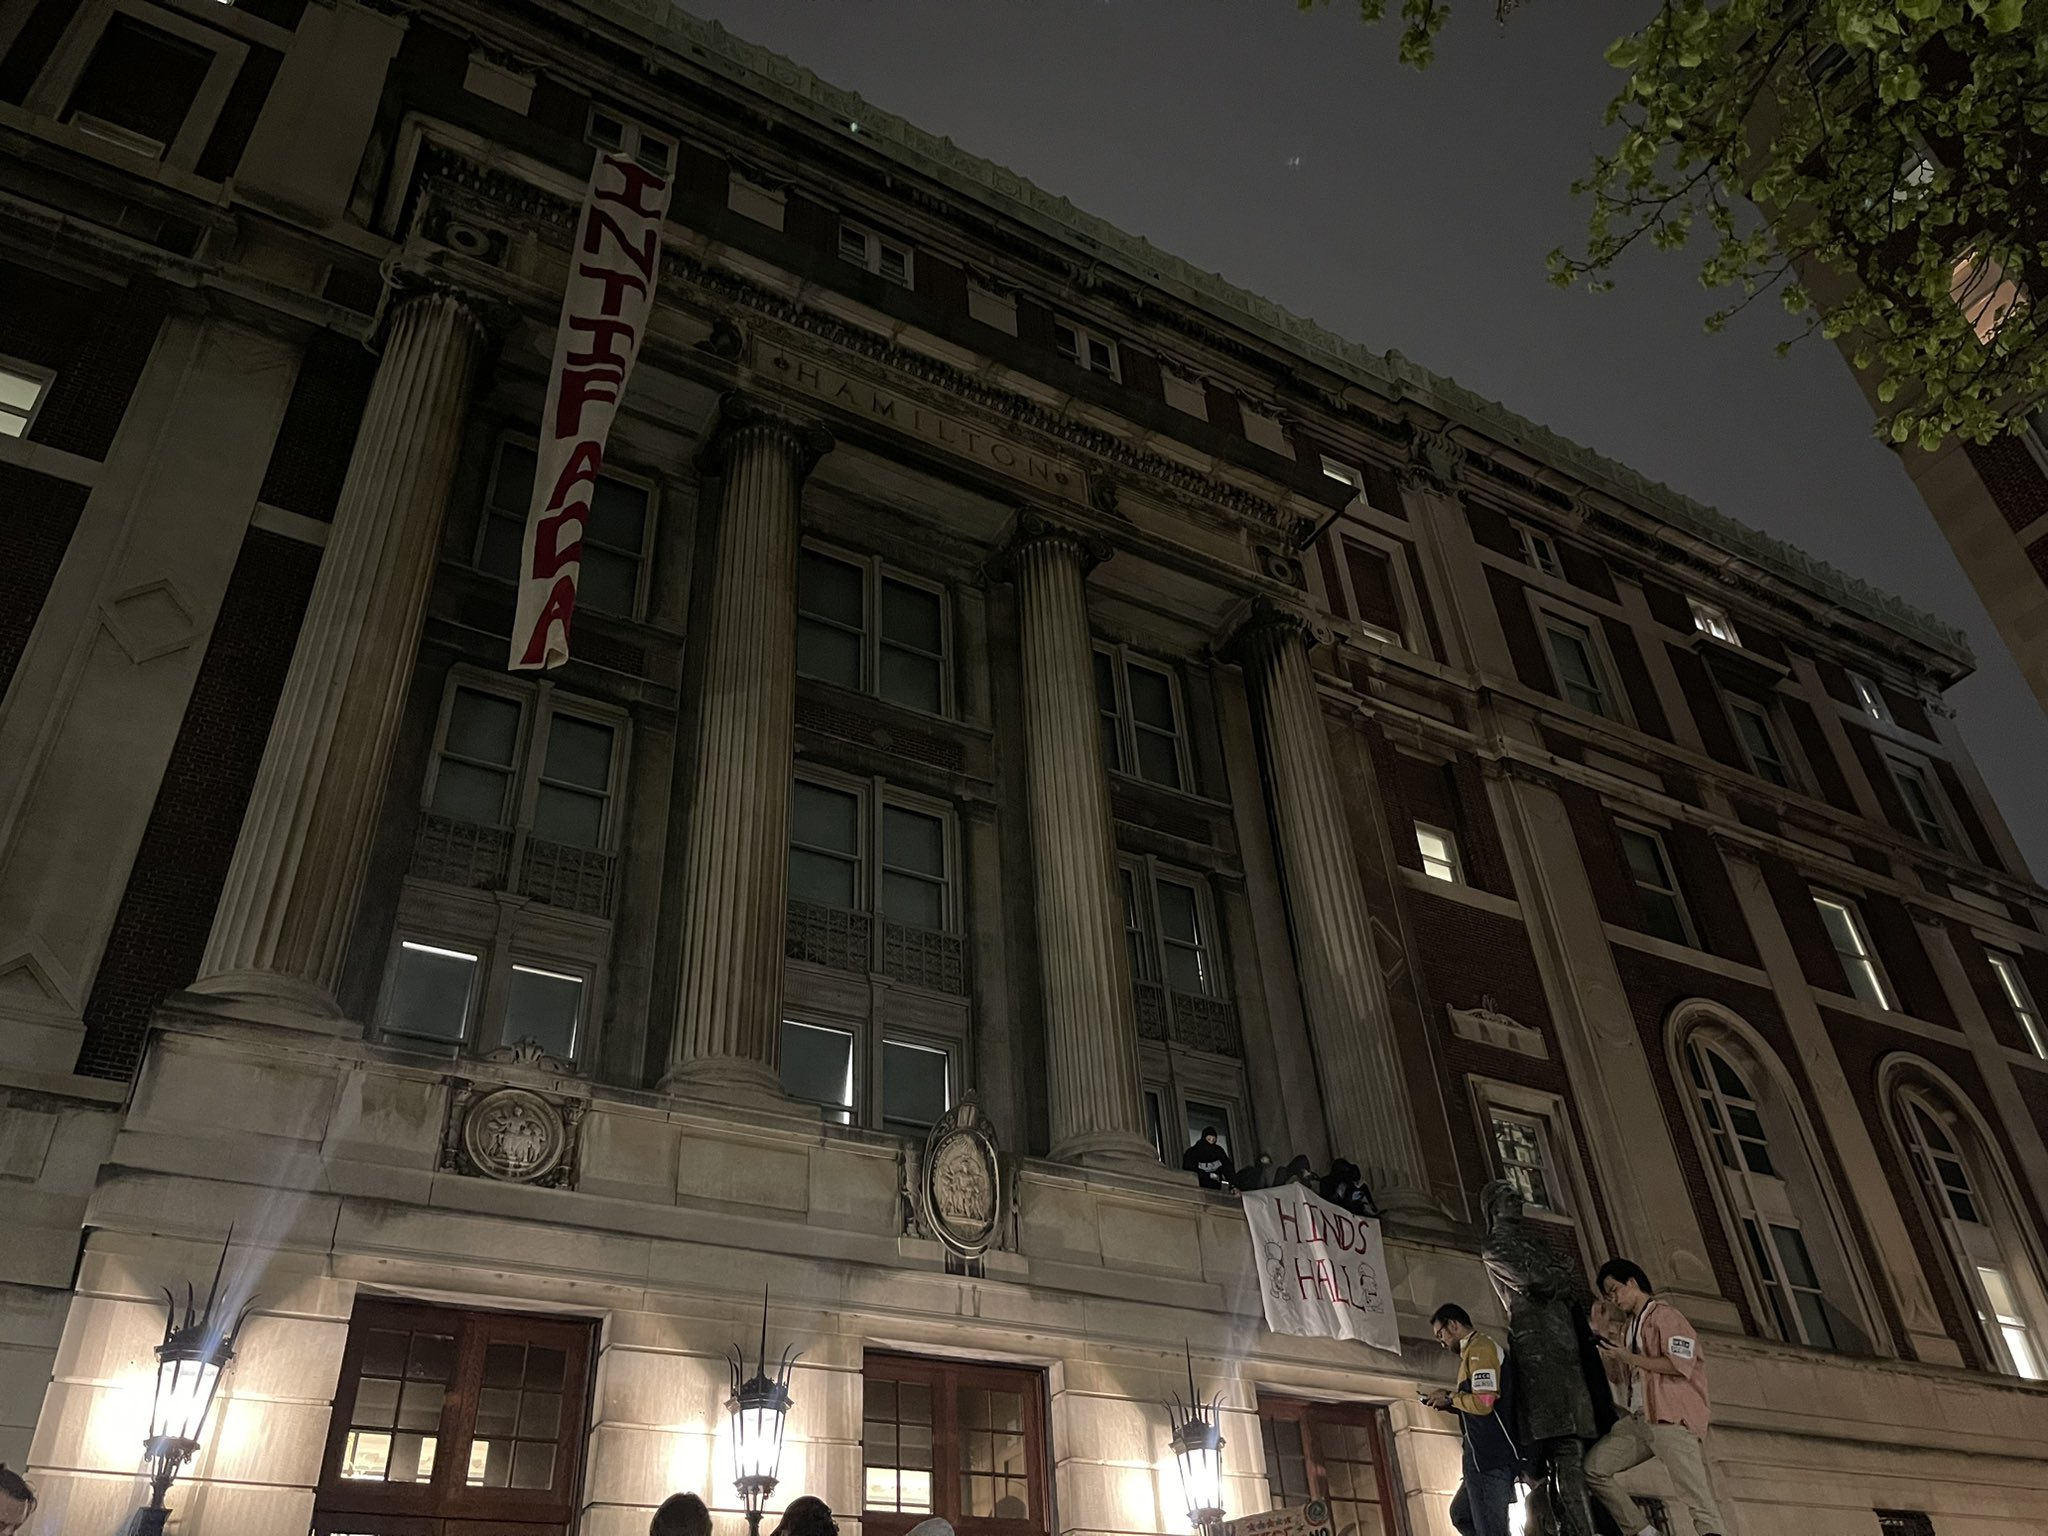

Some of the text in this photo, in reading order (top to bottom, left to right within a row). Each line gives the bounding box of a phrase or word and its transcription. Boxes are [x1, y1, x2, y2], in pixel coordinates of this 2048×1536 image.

[520, 154, 666, 664] INTIFADA
[797, 363, 1050, 481] HAMILTON
[1275, 1198, 1369, 1255] HINDS
[1295, 1258, 1366, 1313] HALL
